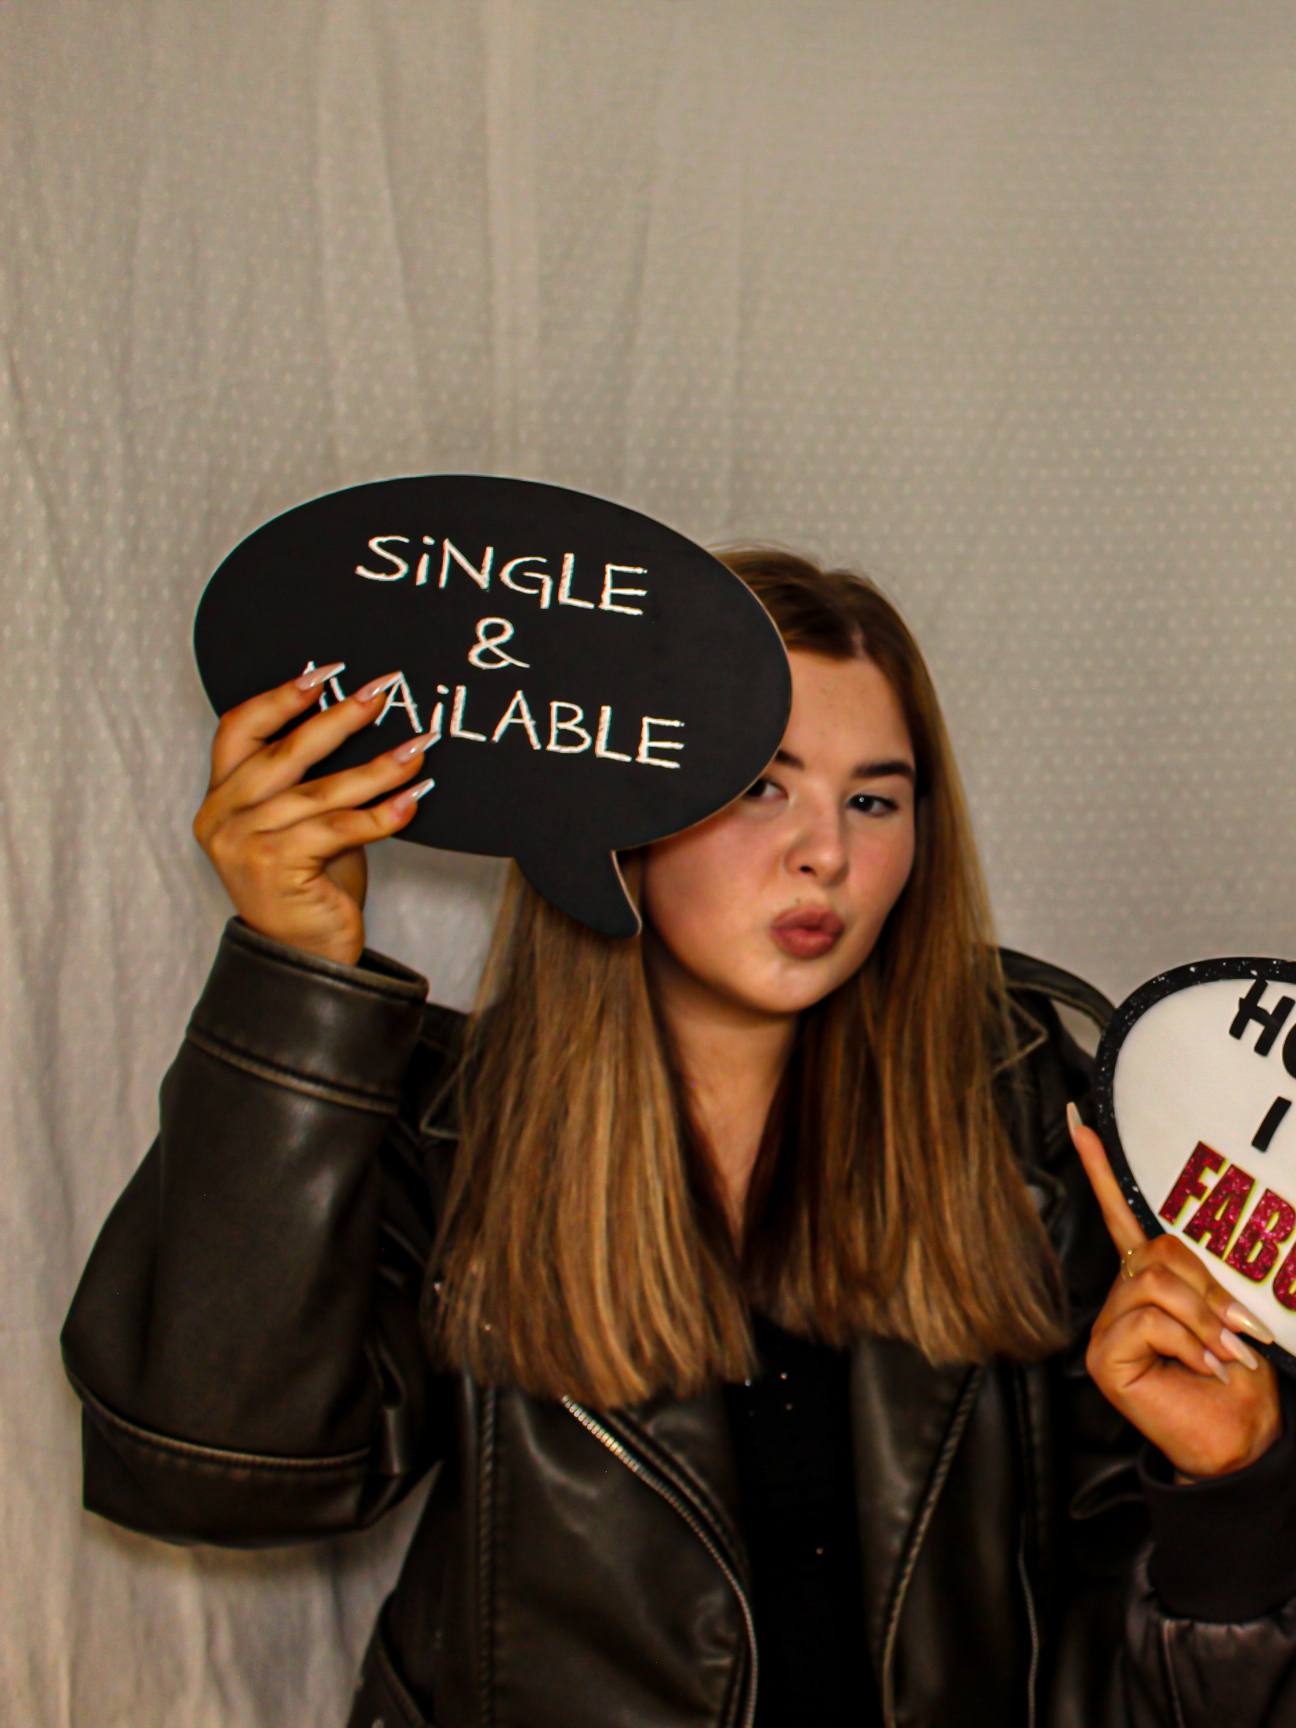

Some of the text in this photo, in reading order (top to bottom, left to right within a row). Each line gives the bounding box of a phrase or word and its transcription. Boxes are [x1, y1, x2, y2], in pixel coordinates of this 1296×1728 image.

[467, 616, 530, 670] &
[302, 660, 686, 769] AiLABLE
[1250, 1095, 1293, 1153] I
